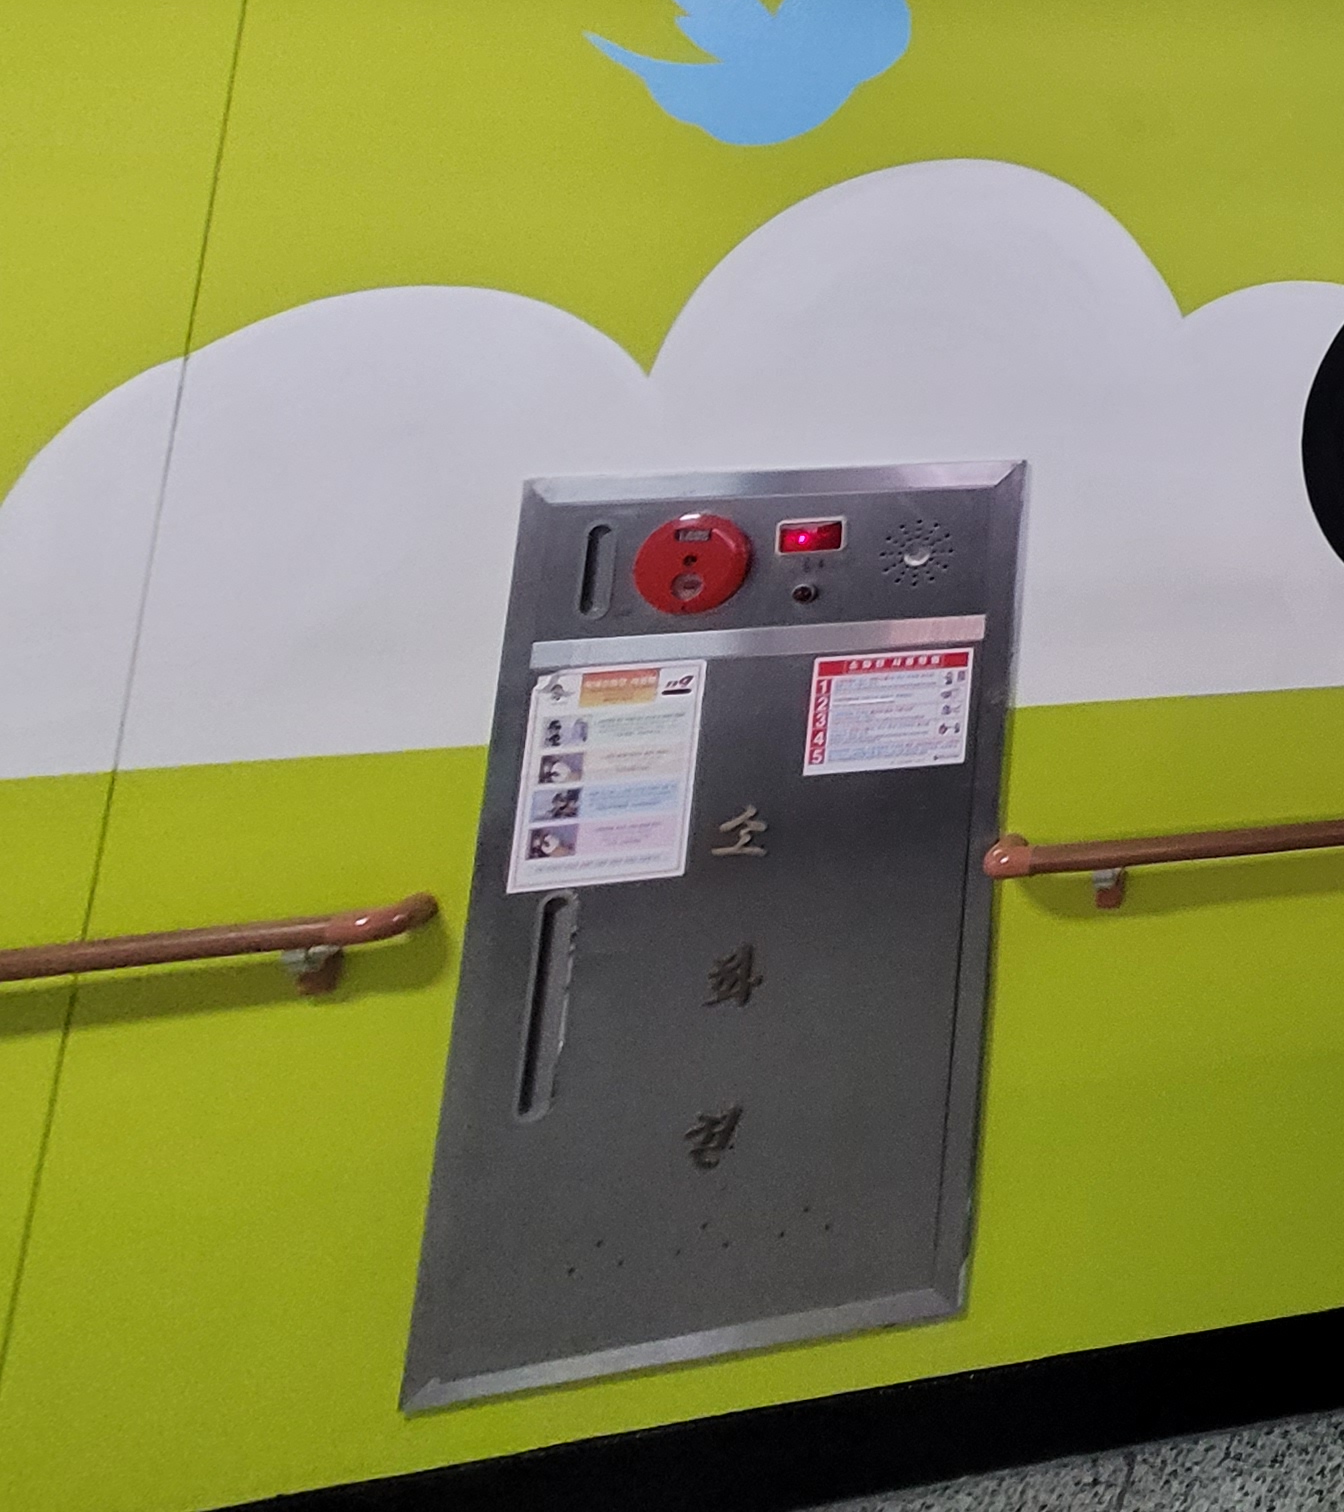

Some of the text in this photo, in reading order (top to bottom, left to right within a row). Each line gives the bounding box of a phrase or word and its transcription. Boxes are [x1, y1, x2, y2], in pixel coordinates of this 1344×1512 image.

[819, 679, 829, 694] 1
[817, 696, 829, 712] 2
[815, 713, 827, 728] 3
[813, 730, 825, 746] 4
[811, 748, 823, 764] 5
